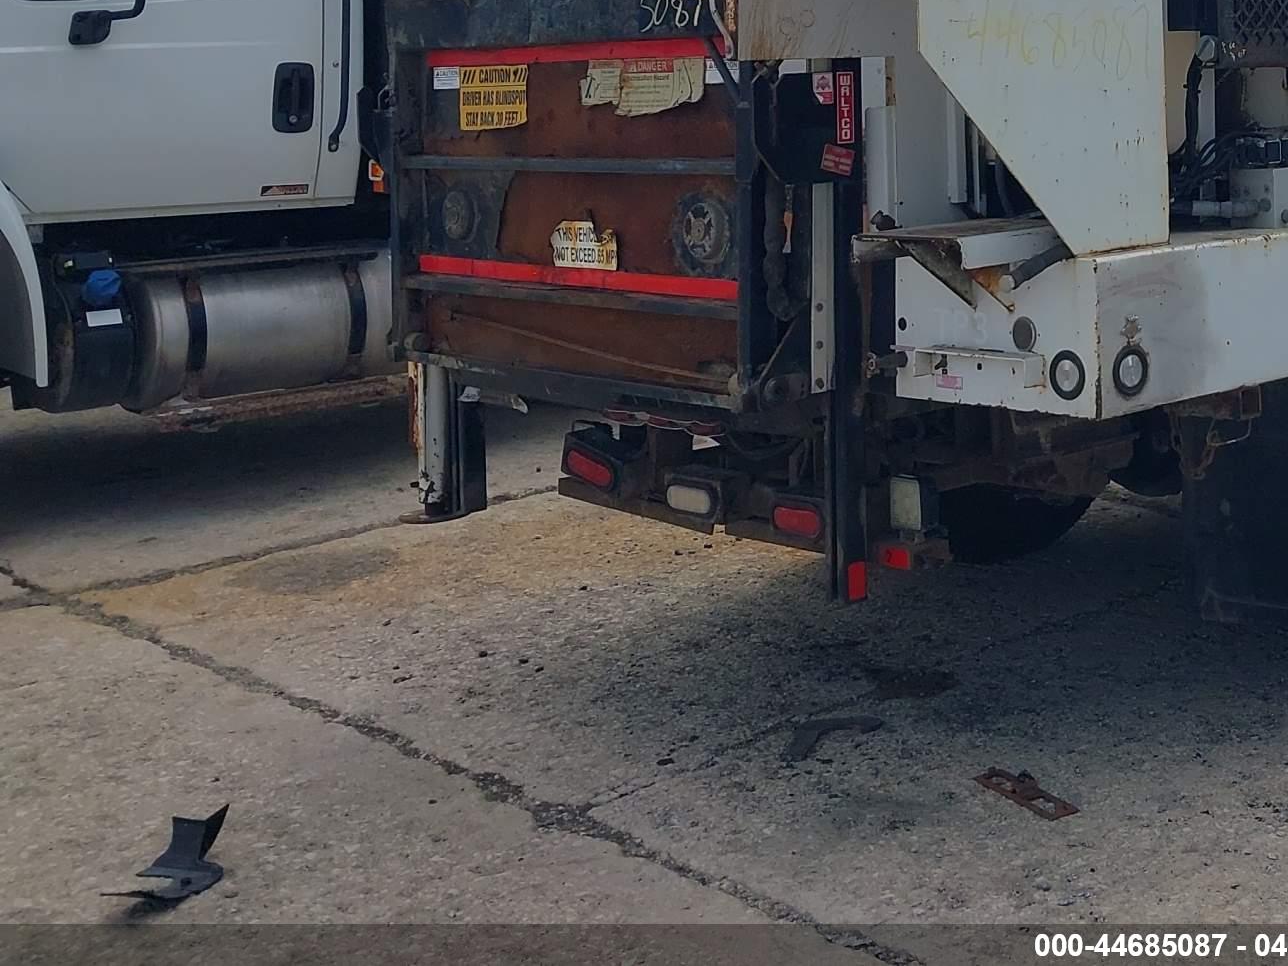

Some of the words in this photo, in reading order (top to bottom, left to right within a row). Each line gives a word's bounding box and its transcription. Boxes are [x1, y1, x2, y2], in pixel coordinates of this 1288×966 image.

[639, 61, 668, 71] DANGER
[479, 68, 511, 83] CAUTION
[463, 91, 482, 106] DRIVER
[483, 90, 494, 106] HAS
[840, 75, 851, 140] WALTCO
[466, 111, 479, 126] STAY
[480, 111, 495, 125] BACK
[504, 111, 518, 125] FEET
[556, 227, 572, 241] THIS
[555, 246, 569, 261] NOT
[571, 247, 596, 263] EXCEED
